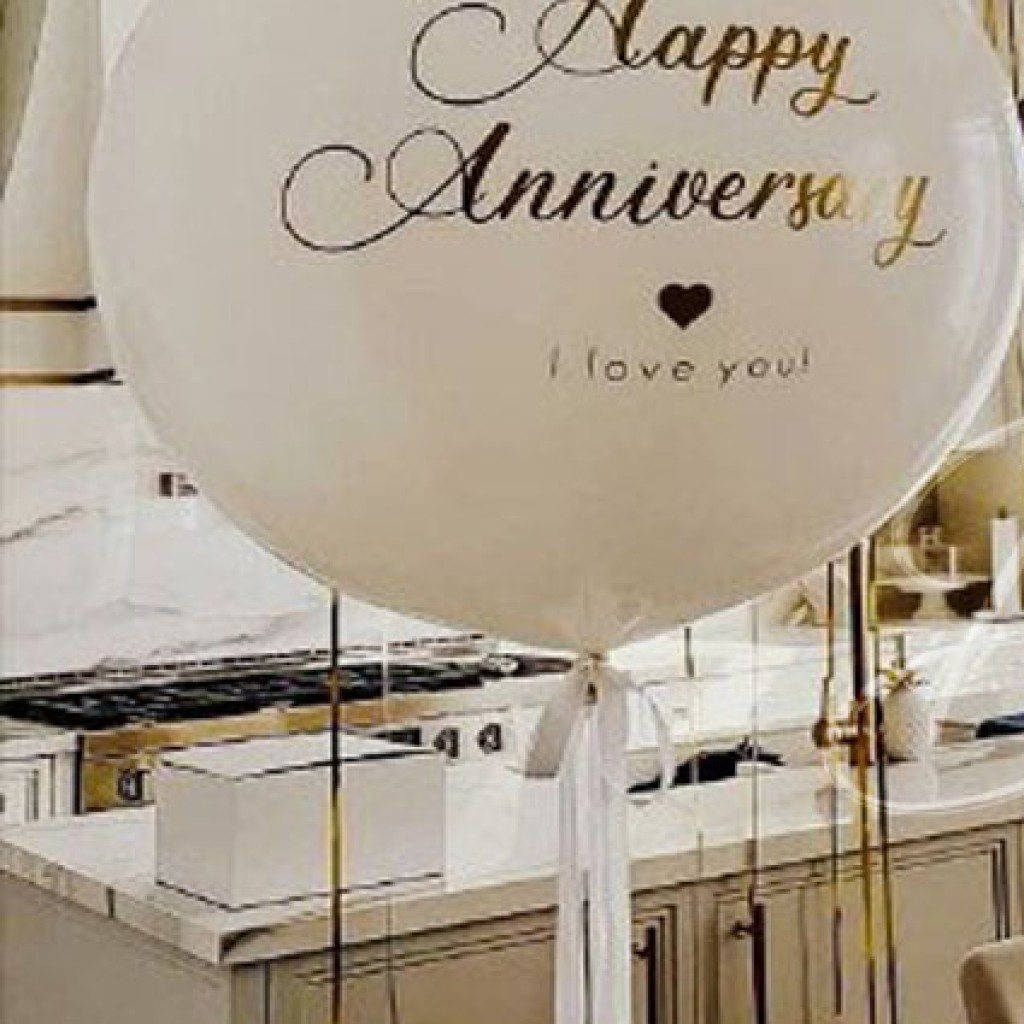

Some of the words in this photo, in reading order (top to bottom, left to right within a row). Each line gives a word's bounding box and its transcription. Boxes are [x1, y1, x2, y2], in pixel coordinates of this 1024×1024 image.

[281, 121, 946, 267] Anniversay
[587, 346, 695, 382] love
[718, 346, 812, 387] you!
